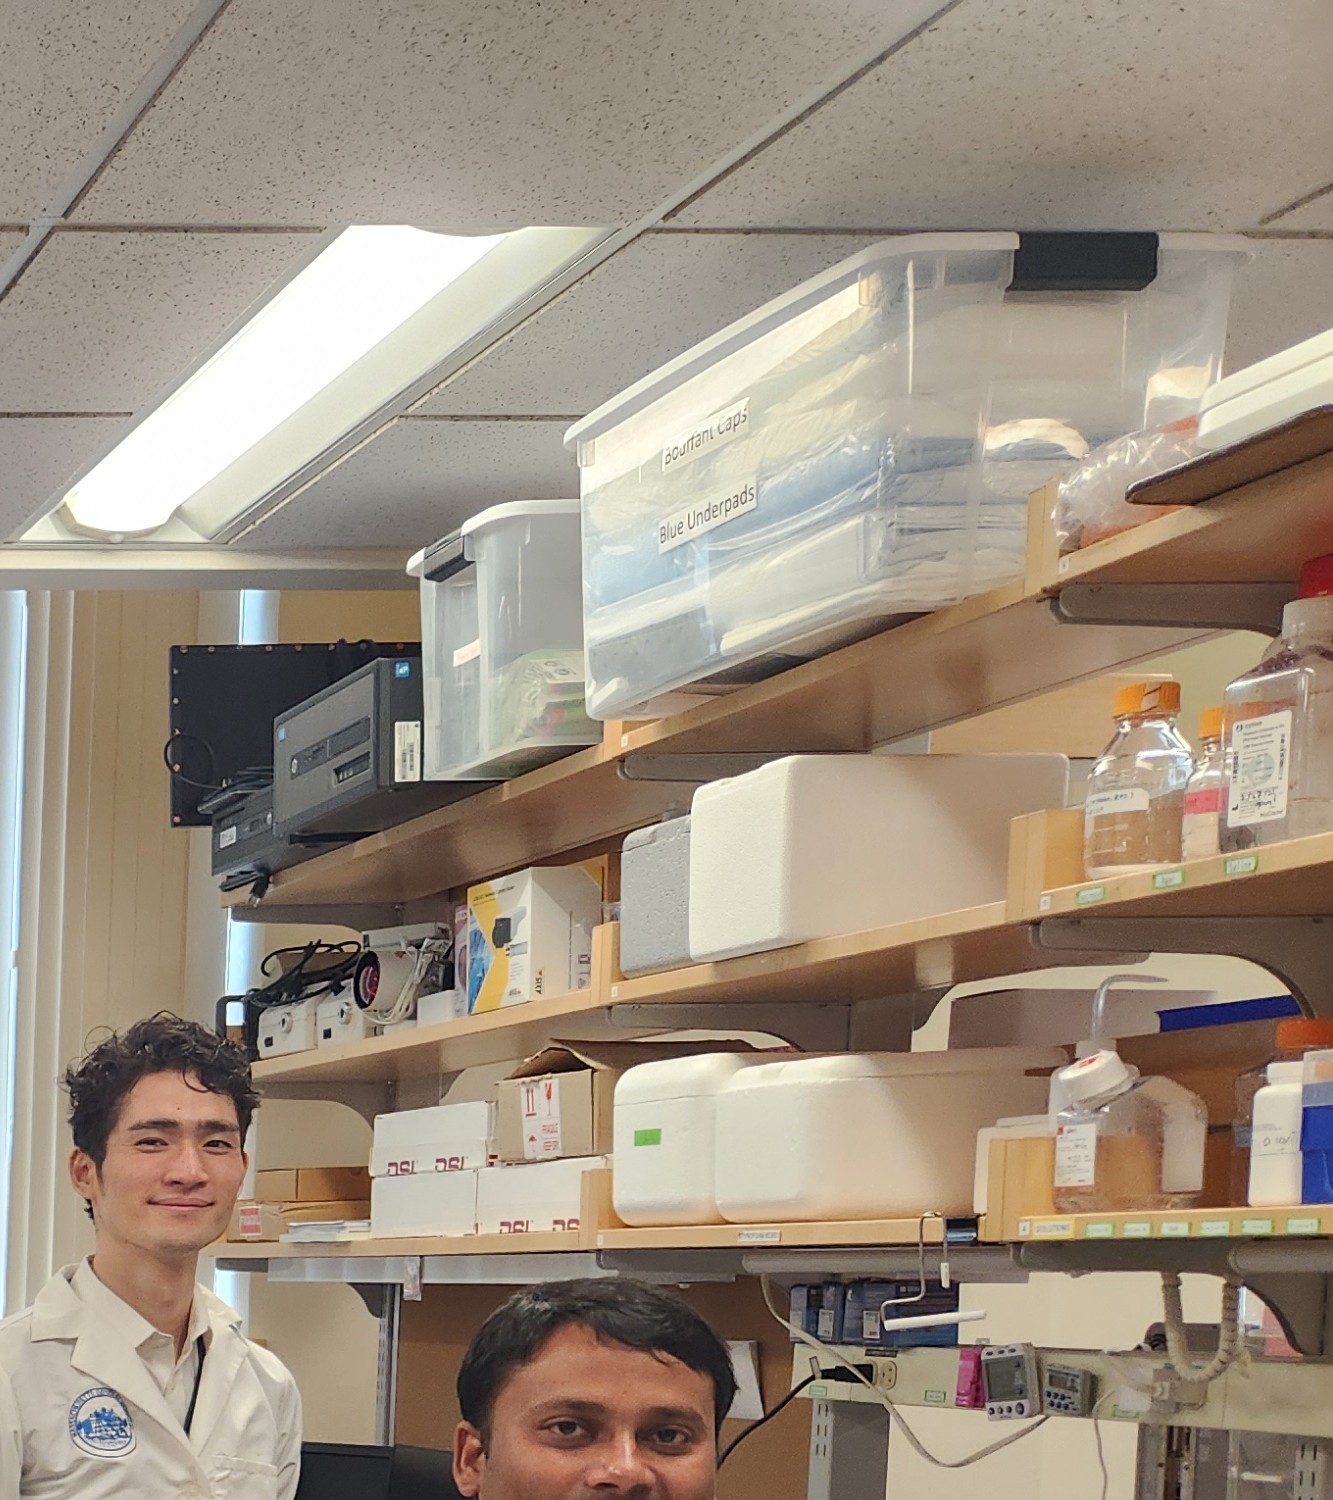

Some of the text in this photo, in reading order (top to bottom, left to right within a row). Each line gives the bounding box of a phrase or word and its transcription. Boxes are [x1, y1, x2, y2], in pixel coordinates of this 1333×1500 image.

[665, 407, 748, 466] Bouffant Caps
[660, 483, 755, 545] Blue Underpads
